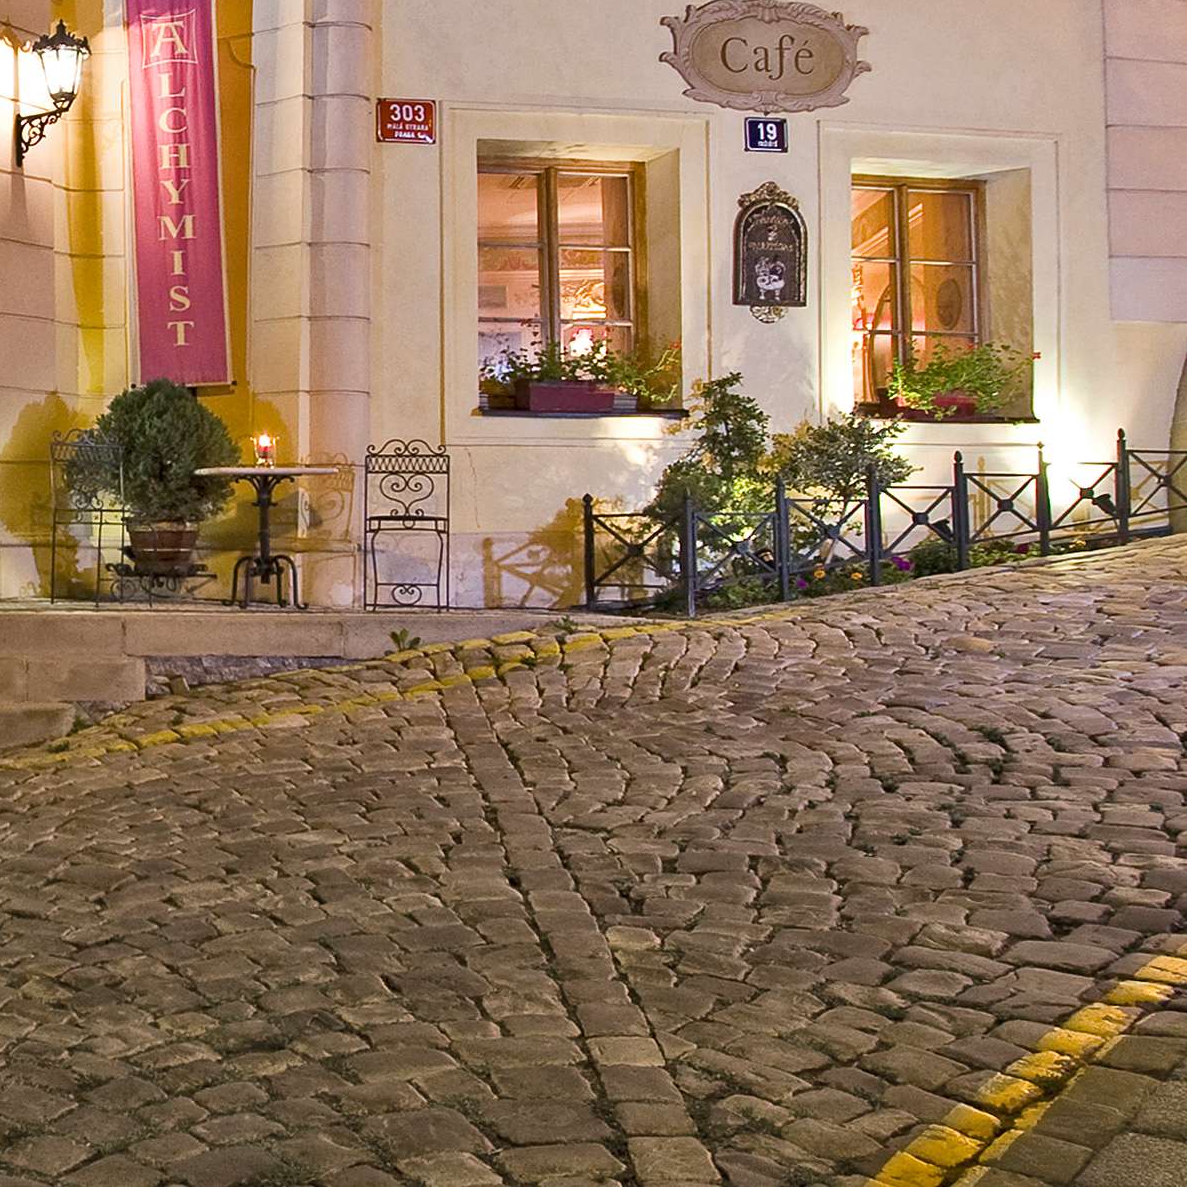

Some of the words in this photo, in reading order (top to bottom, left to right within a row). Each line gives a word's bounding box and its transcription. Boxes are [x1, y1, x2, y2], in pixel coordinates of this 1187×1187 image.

[720, 34, 814, 81] Café
[390, 104, 425, 122] 303
[757, 122, 777, 140] 19
[152, 21, 197, 347] ALCHYMIST
